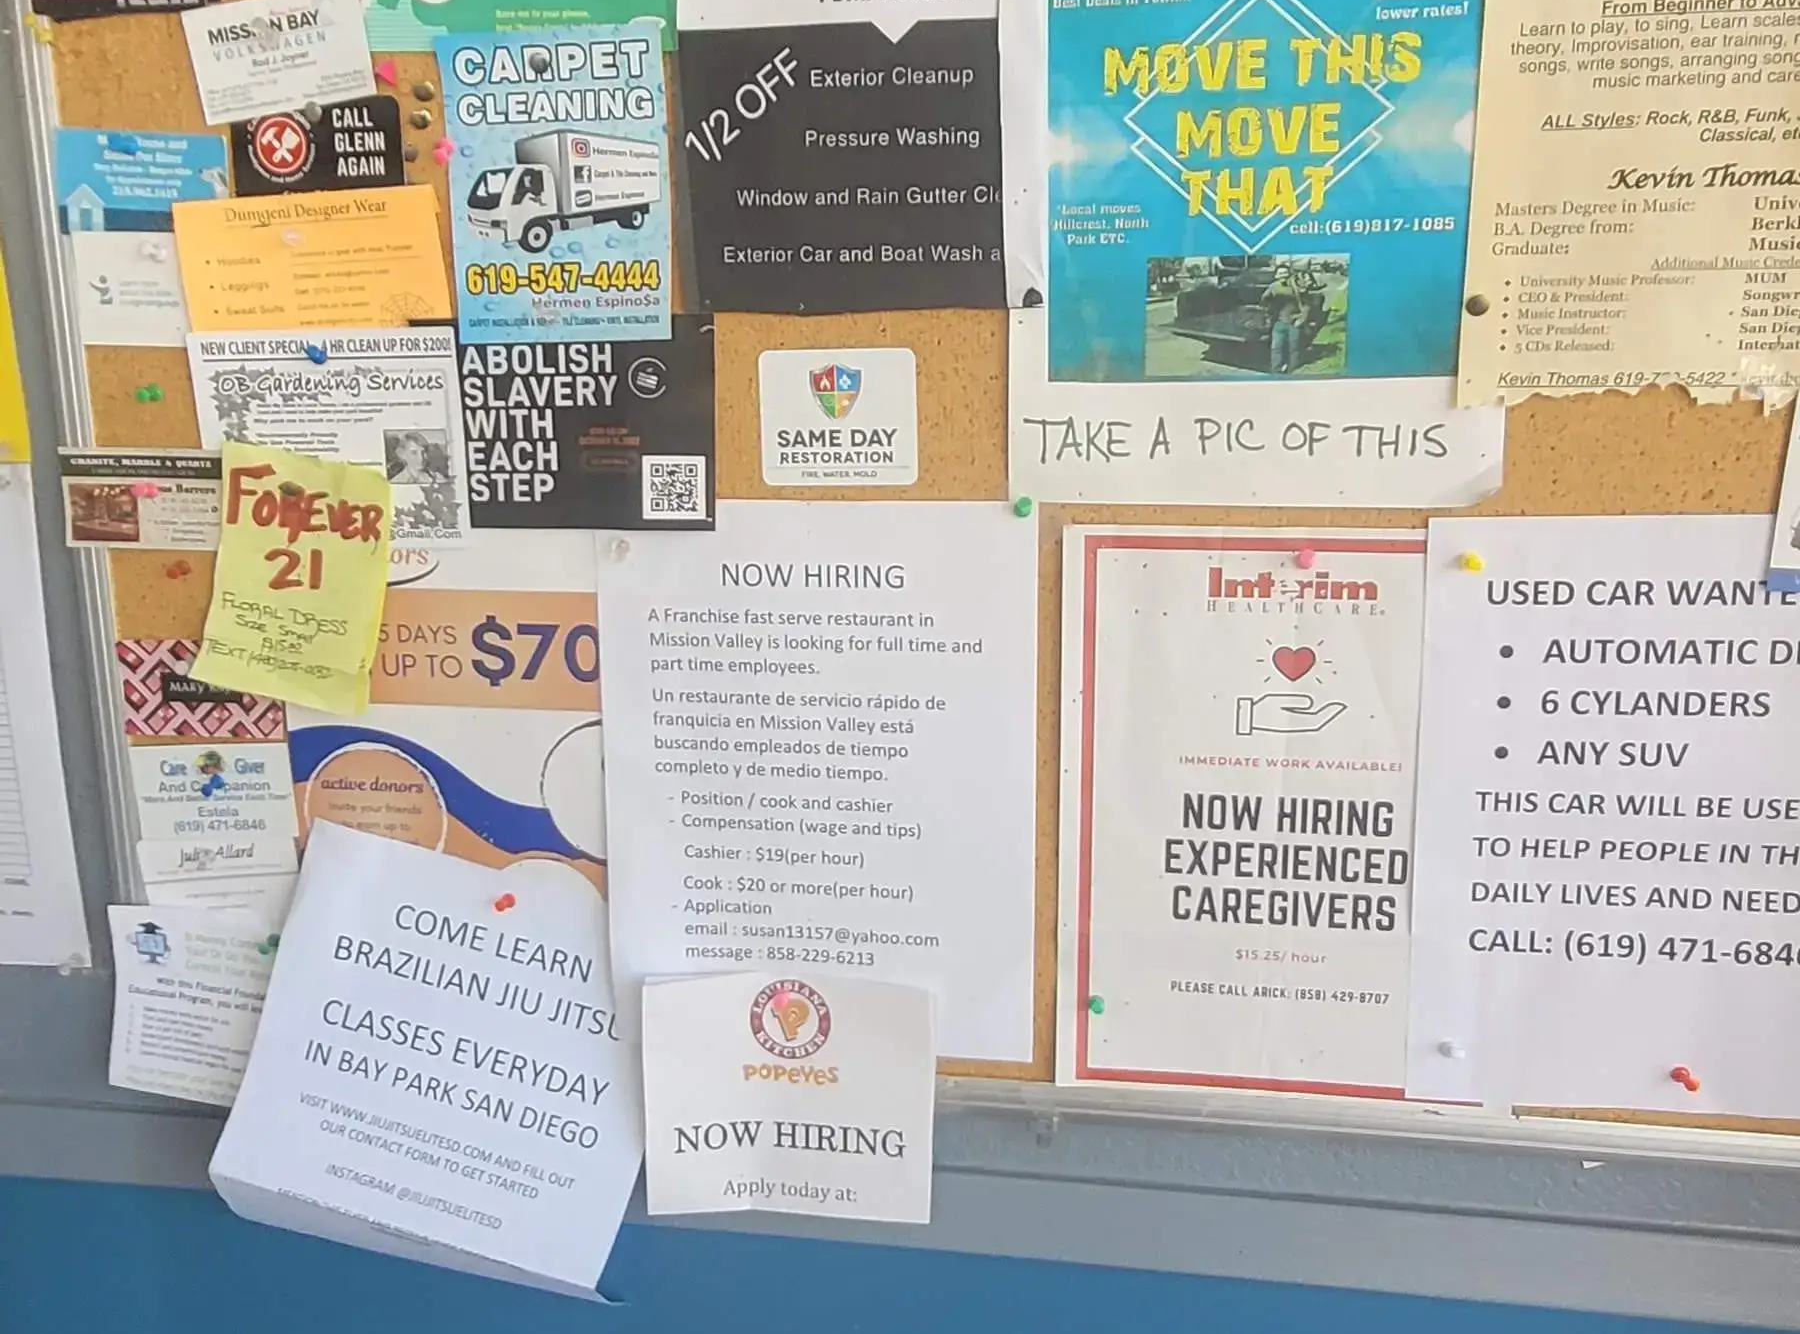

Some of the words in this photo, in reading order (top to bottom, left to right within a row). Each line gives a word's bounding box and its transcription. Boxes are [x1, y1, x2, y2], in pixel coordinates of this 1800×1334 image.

[288, 10, 322, 31] BAY
[1376, 6, 1419, 20] lower
[1423, 1, 1469, 17] rates!
[454, 39, 649, 85] CARPET
[1104, 38, 1267, 96] MOVE
[1290, 32, 1423, 86] THIS
[810, 68, 884, 88] Exterior
[892, 66, 974, 89] Cleanup
[332, 107, 373, 128] CALL
[458, 87, 655, 125] CLEANING
[684, 107, 740, 162] 1/2
[734, 47, 800, 120] OFF
[334, 130, 386, 153] GLENN
[805, 129, 889, 147] Pressure
[896, 127, 980, 149] Washing
[1176, 103, 1341, 160] MOVE
[337, 155, 386, 176] AGAIN
[1607, 167, 1695, 190] Kevin
[737, 189, 808, 207] Window
[815, 188, 849, 205] and
[856, 188, 899, 204] Rain
[906, 186, 966, 204] Gutter
[1182, 166, 1334, 216] THAT
[294, 203, 350, 221] Designer
[355, 199, 387, 213] Wear
[1289, 217, 1455, 235] cell:(619)817-1085
[723, 246, 793, 263] Exterior
[800, 246, 832, 263] Car
[839, 246, 873, 262] and
[881, 245, 924, 262] Boat
[931, 244, 983, 261] Wash
[466, 259, 660, 295] 619-547-4444
[532, 296, 591, 309] Hermen
[596, 295, 660, 308] Espino$a
[201, 341, 225, 355] NEW
[227, 340, 265, 355] CLIENT
[330, 340, 344, 353] HR
[347, 338, 382, 353] CLEAN
[383, 338, 397, 351] UP
[400, 337, 421, 351] FOR
[462, 344, 613, 375] ABOLISH
[220, 375, 250, 393] OB
[257, 370, 361, 397] Gardening
[367, 369, 444, 390] Services
[464, 375, 618, 408] SLAVERY
[466, 408, 554, 440] WITH
[777, 429, 842, 448] SAME
[850, 428, 897, 447] DAY
[1023, 417, 1132, 464] TAKE
[1149, 417, 1170, 460] A
[1194, 418, 1265, 456] PIC
[1281, 421, 1331, 457] OF
[1342, 424, 1448, 458] THIS
[468, 440, 559, 472] EACH
[780, 451, 893, 465] RESTORATION
[470, 473, 555, 503] STEP
[226, 463, 384, 543] FOREVER
[264, 548, 323, 590] 21
[721, 563, 794, 588] NOW
[804, 564, 905, 590] HIRING
[1487, 580, 1576, 607] USED
[1585, 580, 1657, 608] CAR
[222, 591, 285, 620] FLORAL
[288, 607, 348, 637] DRESS
[648, 609, 659, 623] A
[664, 608, 739, 625] Franchise
[744, 609, 774, 625] fast
[779, 613, 822, 625] serve
[827, 612, 913, 627] restaurant
[919, 613, 934, 627] in
[397, 624, 457, 644] DAYS
[650, 633, 710, 649] Mission
[715, 634, 763, 653] Valley
[767, 635, 780, 650] is
[784, 636, 843, 654] looking
[849, 636, 872, 652] for
[877, 637, 903, 652] full
[908, 638, 946, 653] time
[951, 639, 982, 654] and
[1542, 638, 1759, 666] AUTOMATIC
[382, 654, 416, 677] UP
[425, 654, 463, 678] TO
[169, 680, 205, 695] MARY
[1540, 691, 1559, 716] 6
[1570, 689, 1772, 719] CYLANDERS
[160, 760, 187, 776] Care
[234, 757, 265, 775] Giver
[1537, 741, 1609, 767] ANY
[1618, 741, 1691, 768] SUV
[159, 781, 186, 792] And
[321, 777, 365, 791] active
[369, 776, 424, 794] donors
[197, 806, 239, 818] Estela
[1181, 792, 1262, 832] NOW
[1277, 796, 1394, 838] HIRING
[174, 820, 205, 834] (619)
[208, 819, 266, 831] 471-6846
[1164, 839, 1409, 886] EXPERIENCED
[1171, 885, 1397, 932] CAREGIVERS
[394, 903, 487, 952] COME
[495, 932, 593, 984] LEARN
[742, 924, 939, 948] susan13157@yahoo.com
[1468, 928, 1554, 956] CALL:
[1563, 929, 1648, 965] (619)
[685, 946, 752, 962] message
[767, 946, 875, 966] 858-229-6213
[333, 934, 490, 1002] BRAZILIAN
[496, 981, 543, 1016] JIU
[1170, 981, 1214, 995] PLEASE
[1219, 983, 1248, 998] CALL
[1253, 986, 1292, 1000] ARICK:
[1295, 987, 1328, 1002] (858)
[1331, 989, 1390, 1005] 429-8707
[322, 999, 445, 1057] CLASSES
[451, 1038, 610, 1107] EVERYDAY
[756, 1031, 826, 1059] KITCHEN
[304, 1039, 332, 1067] IN
[337, 1050, 389, 1082] BAY
[391, 1067, 459, 1105] PARK
[460, 1088, 514, 1123] SAN
[519, 1107, 599, 1150] DIEGO
[674, 1120, 763, 1154] NOW
[774, 1122, 907, 1158] HIRING
[723, 1177, 775, 1198] Apply
[780, 1182, 830, 1202] today
[835, 1187, 856, 1202] at:
